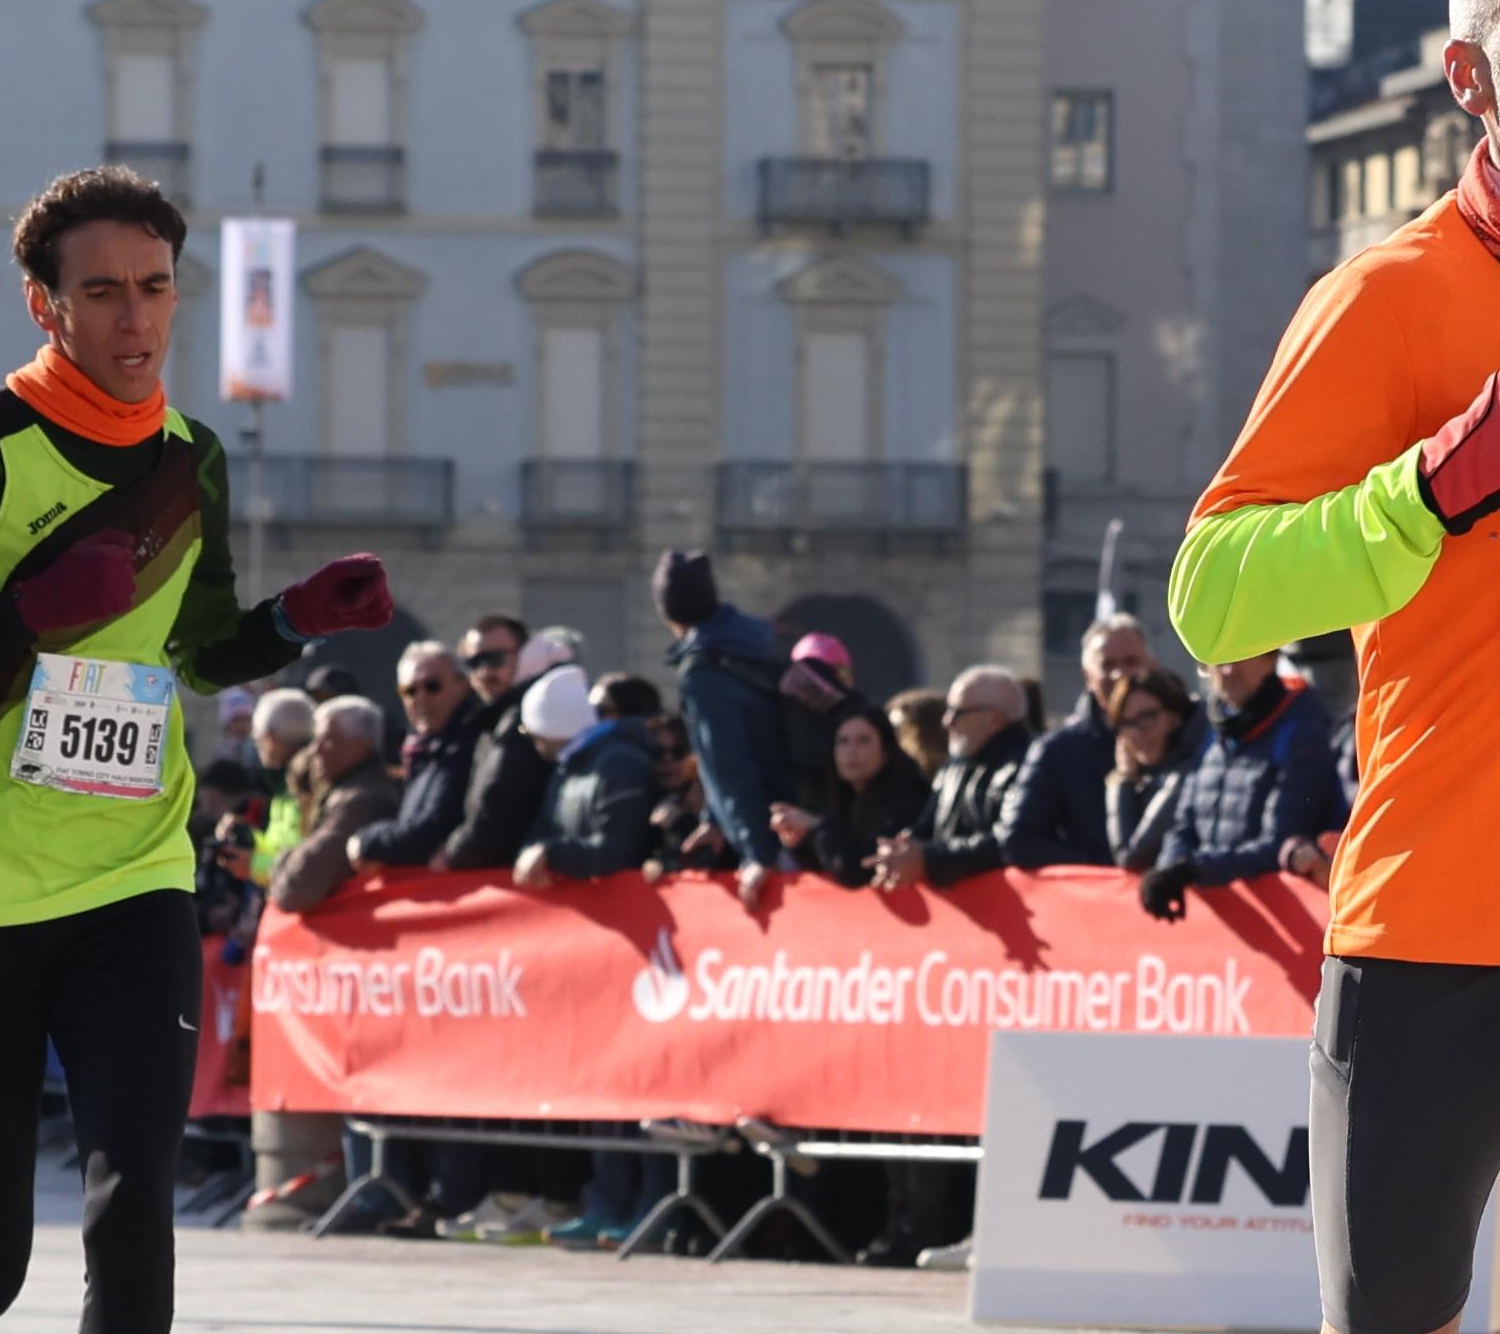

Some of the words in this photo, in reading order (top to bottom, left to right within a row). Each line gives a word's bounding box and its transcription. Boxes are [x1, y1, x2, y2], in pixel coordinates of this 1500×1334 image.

[68, 661, 108, 695] FIAT
[60, 713, 140, 766] 5139
[414, 947, 527, 1018] Bank
[687, 948, 915, 1025] Santander
[915, 952, 1133, 1030] Consumer
[1135, 954, 1253, 1035] Bank
[1122, 1212, 1172, 1231] FIND
[1178, 1214, 1239, 1232] YOUR
[1243, 1216, 1314, 1234] ATTITU
